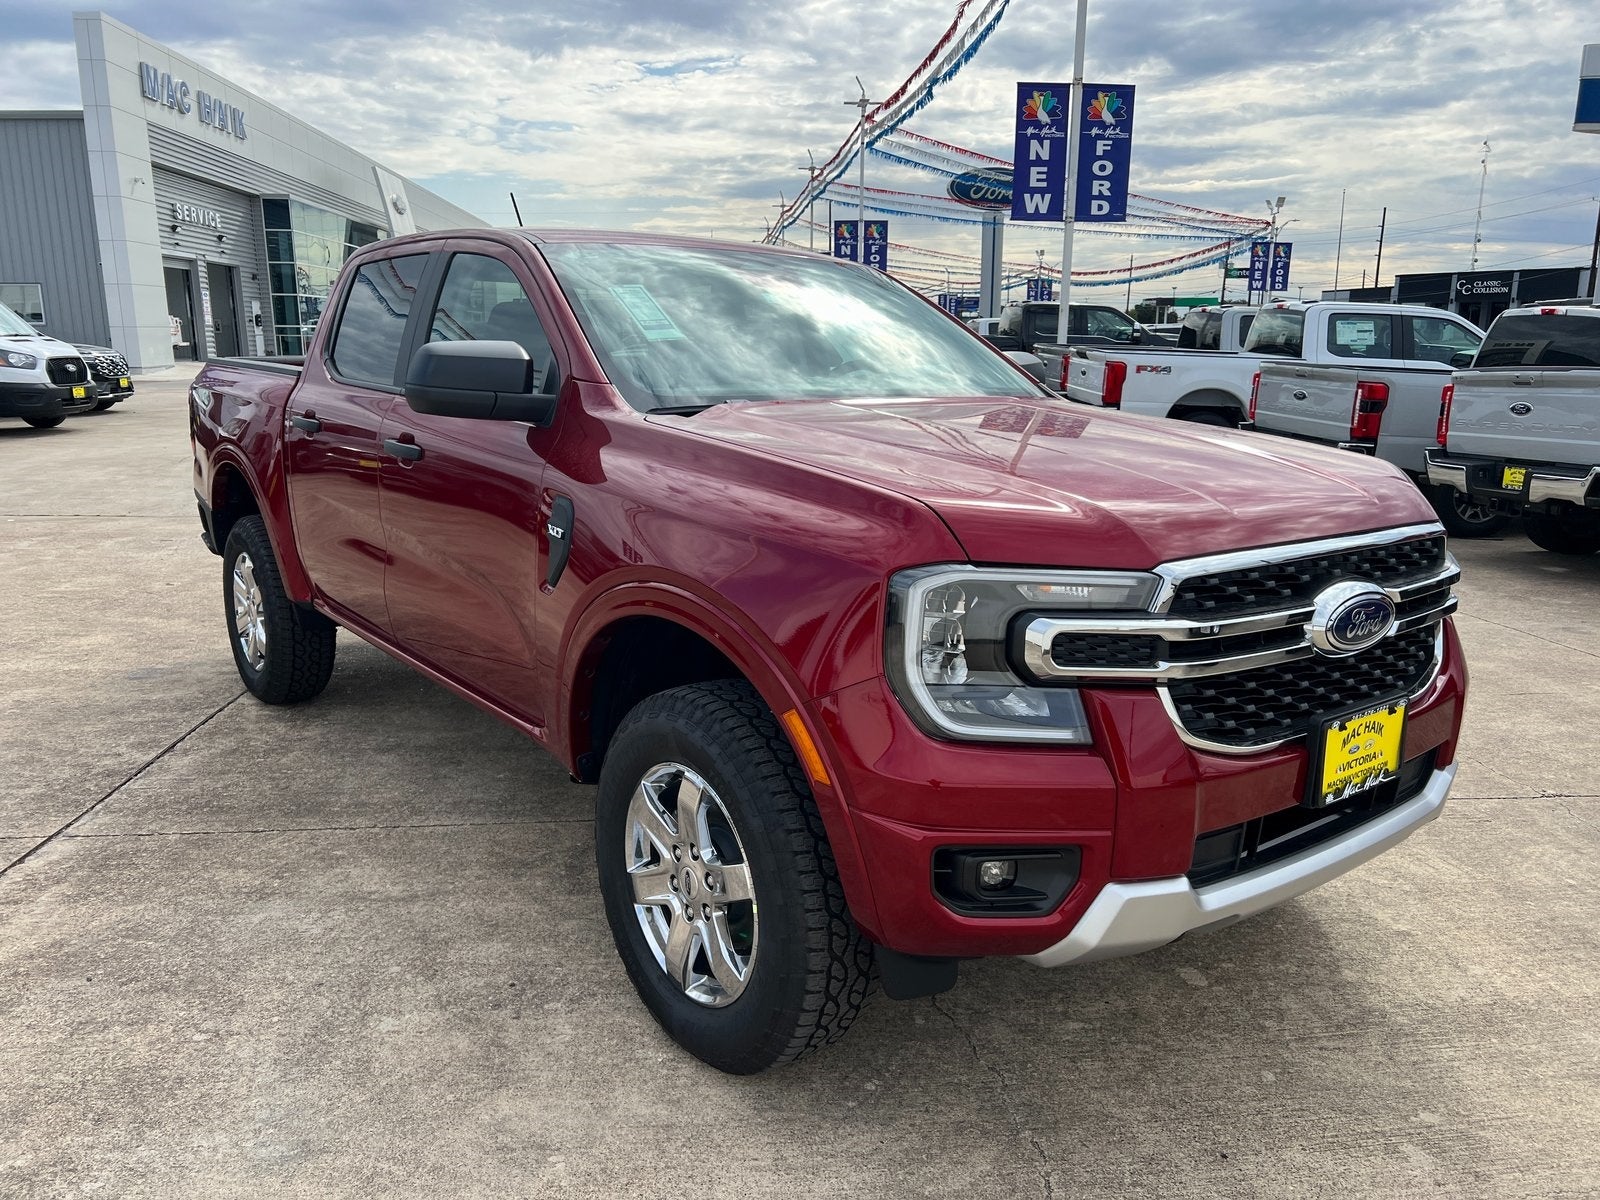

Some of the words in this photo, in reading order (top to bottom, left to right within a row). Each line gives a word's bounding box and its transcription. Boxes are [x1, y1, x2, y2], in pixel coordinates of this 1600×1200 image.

[140, 61, 191, 114] MAC
[198, 89, 247, 140] HAIK
[1023, 139, 1052, 214] NEW
[1090, 140, 1114, 216] FORD
[175, 202, 222, 228] SERVICE
[1251, 261, 1264, 289] NEW
[1274, 262, 1284, 290] FORD
[1135, 364, 1172, 374] FX4
[547, 523, 565, 539] XLT
[1346, 606, 1384, 639] Ford
[1341, 724, 1363, 751] MAC
[1364, 721, 1385, 738] HAIK
[1341, 751, 1377, 773] VICTORIA
